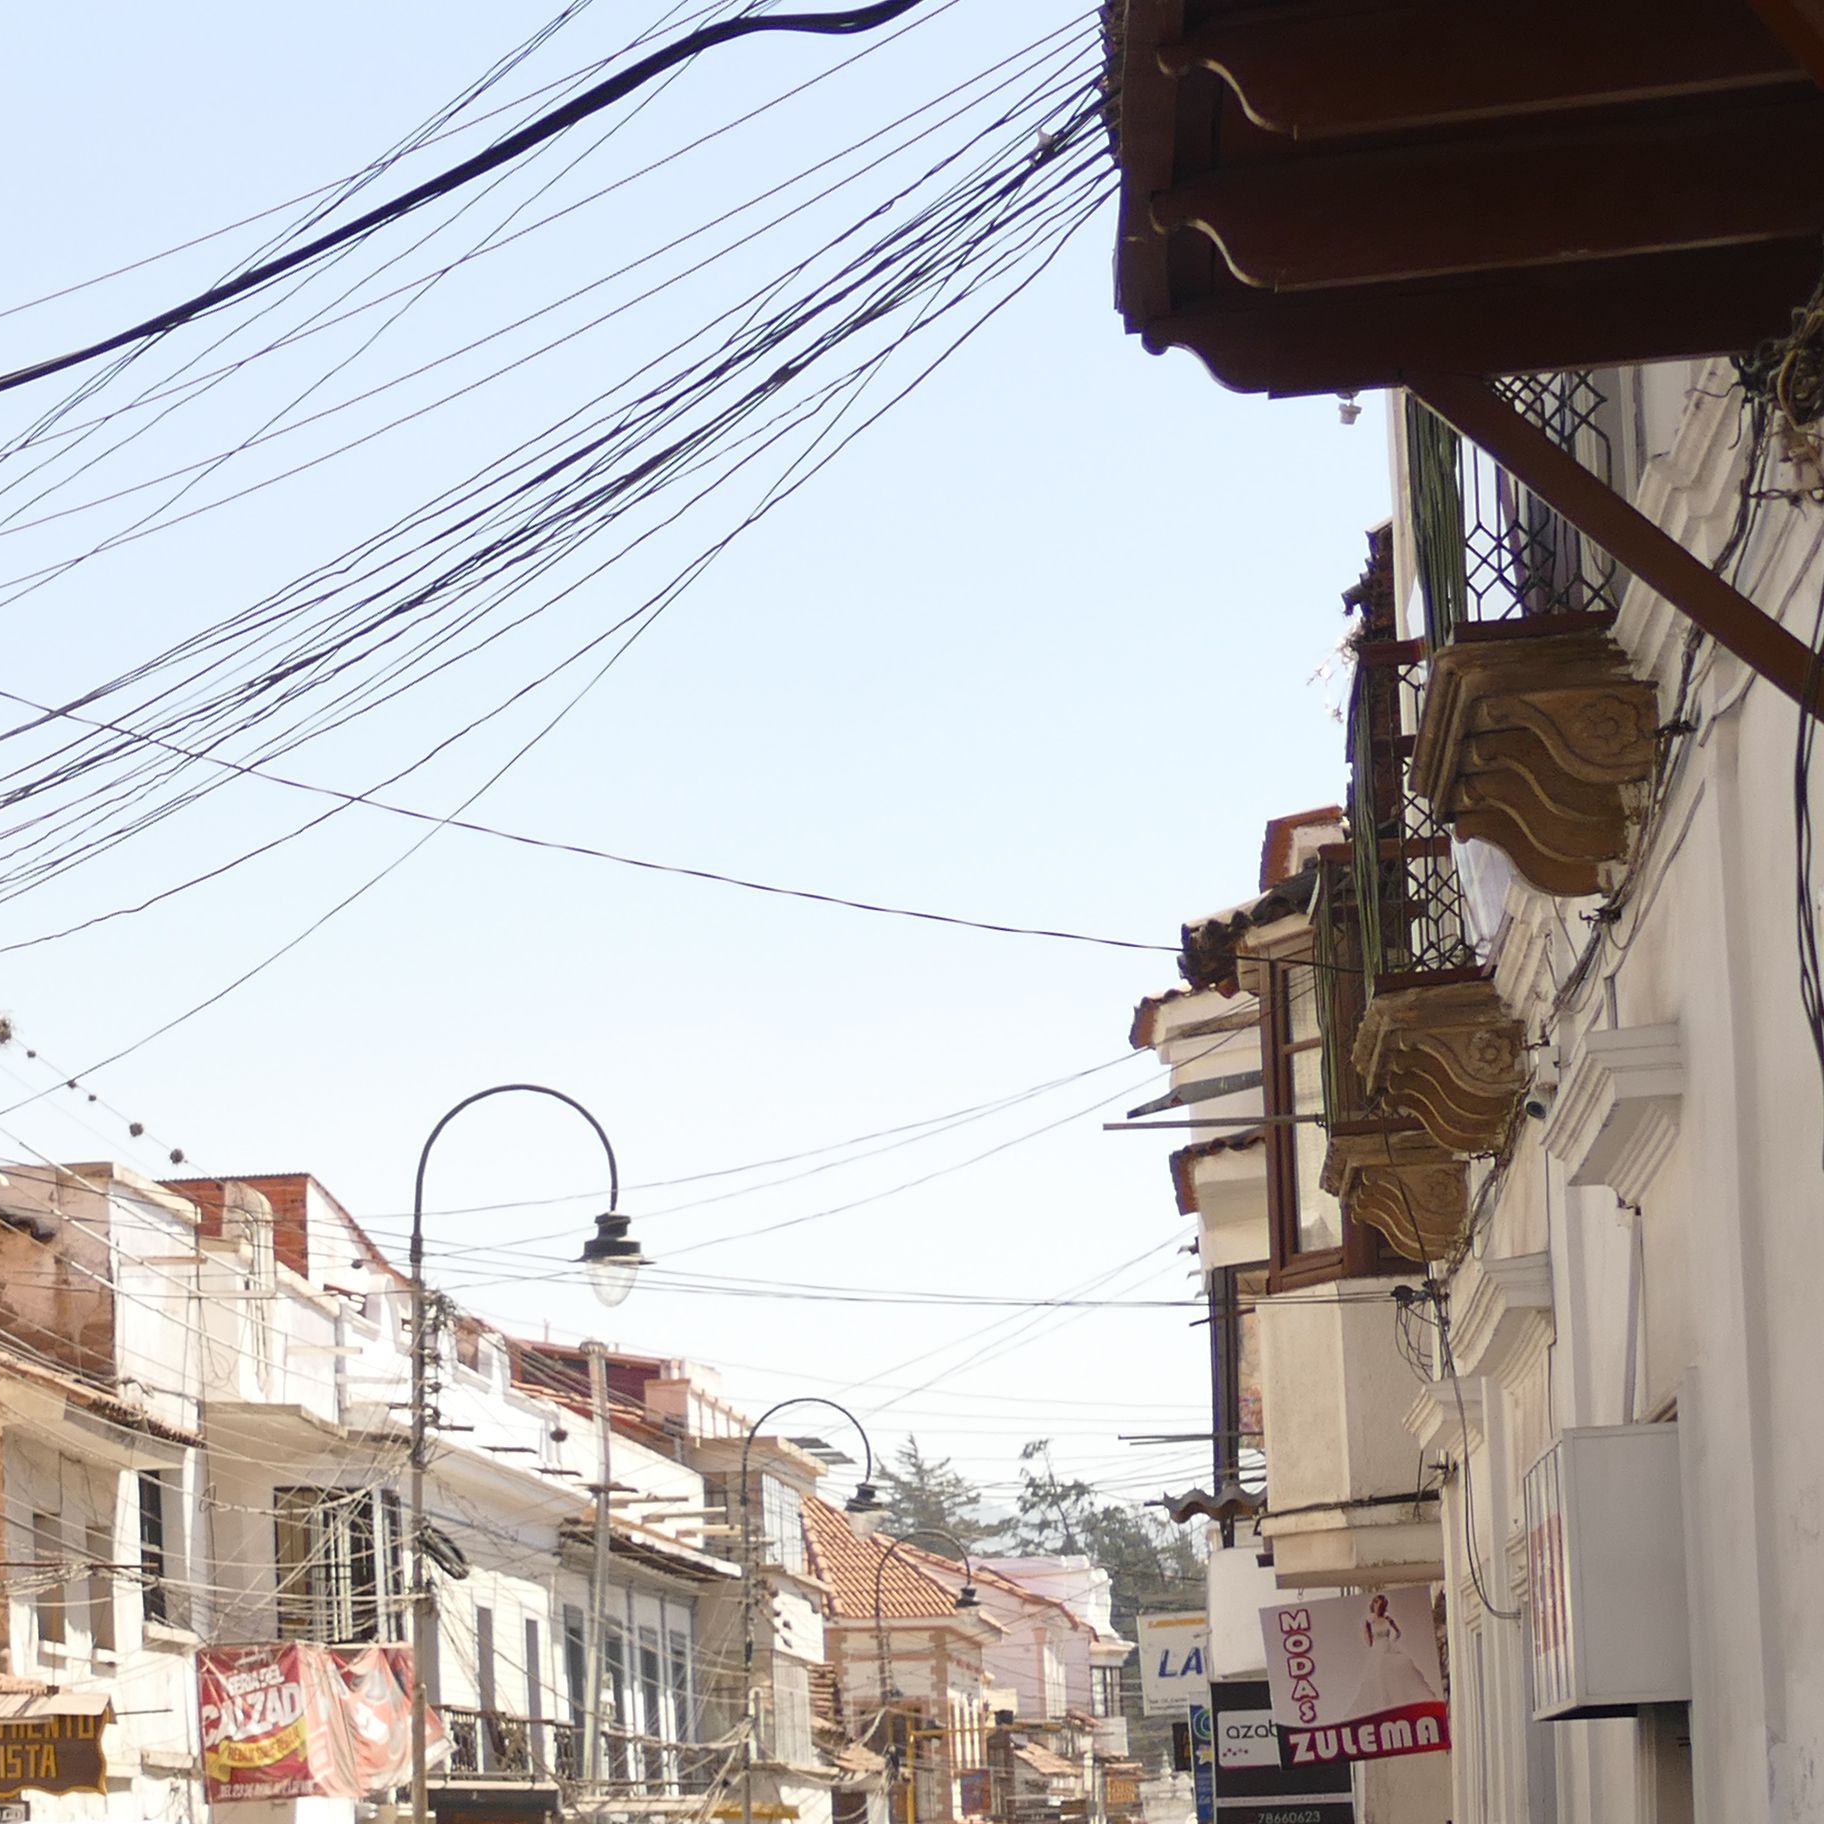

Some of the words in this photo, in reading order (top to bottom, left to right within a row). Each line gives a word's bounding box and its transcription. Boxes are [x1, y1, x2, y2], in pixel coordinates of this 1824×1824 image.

[1278, 1608, 1319, 1725] MODAS
[1289, 1715, 1440, 1765] ZULEMA
[1257, 1809, 1322, 1824] 78660623
